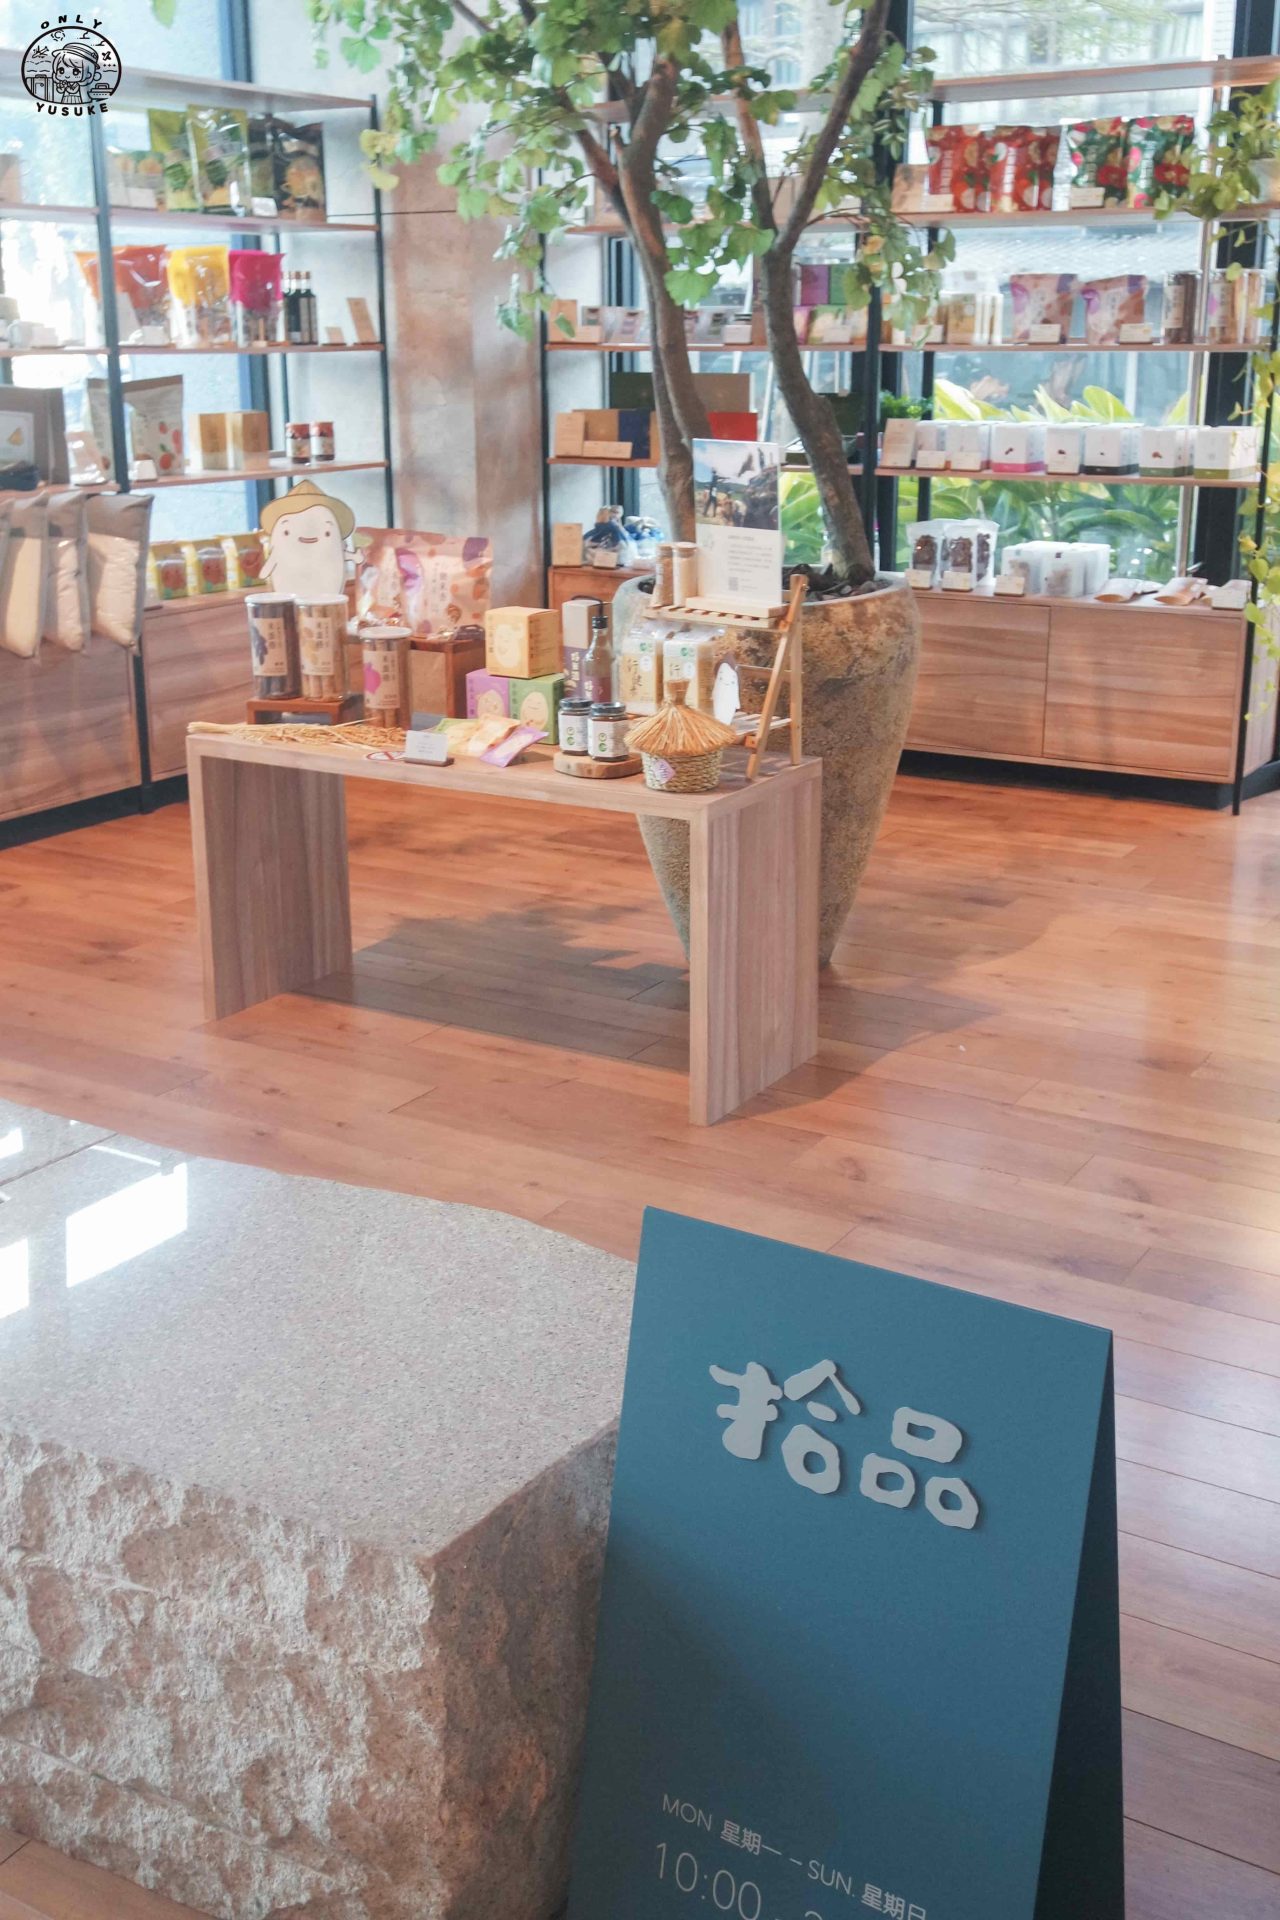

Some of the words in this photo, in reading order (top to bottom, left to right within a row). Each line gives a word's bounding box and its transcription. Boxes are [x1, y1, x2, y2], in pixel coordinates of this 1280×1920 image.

[709, 1359, 980, 1530] 拾品
[656, 1842, 762, 1920] 10:00
[662, 1793, 713, 1832] MON
[719, 1819, 783, 1856] 星期一
[807, 1859, 855, 1898] SUN.
[860, 1882, 927, 1920] 星期日
